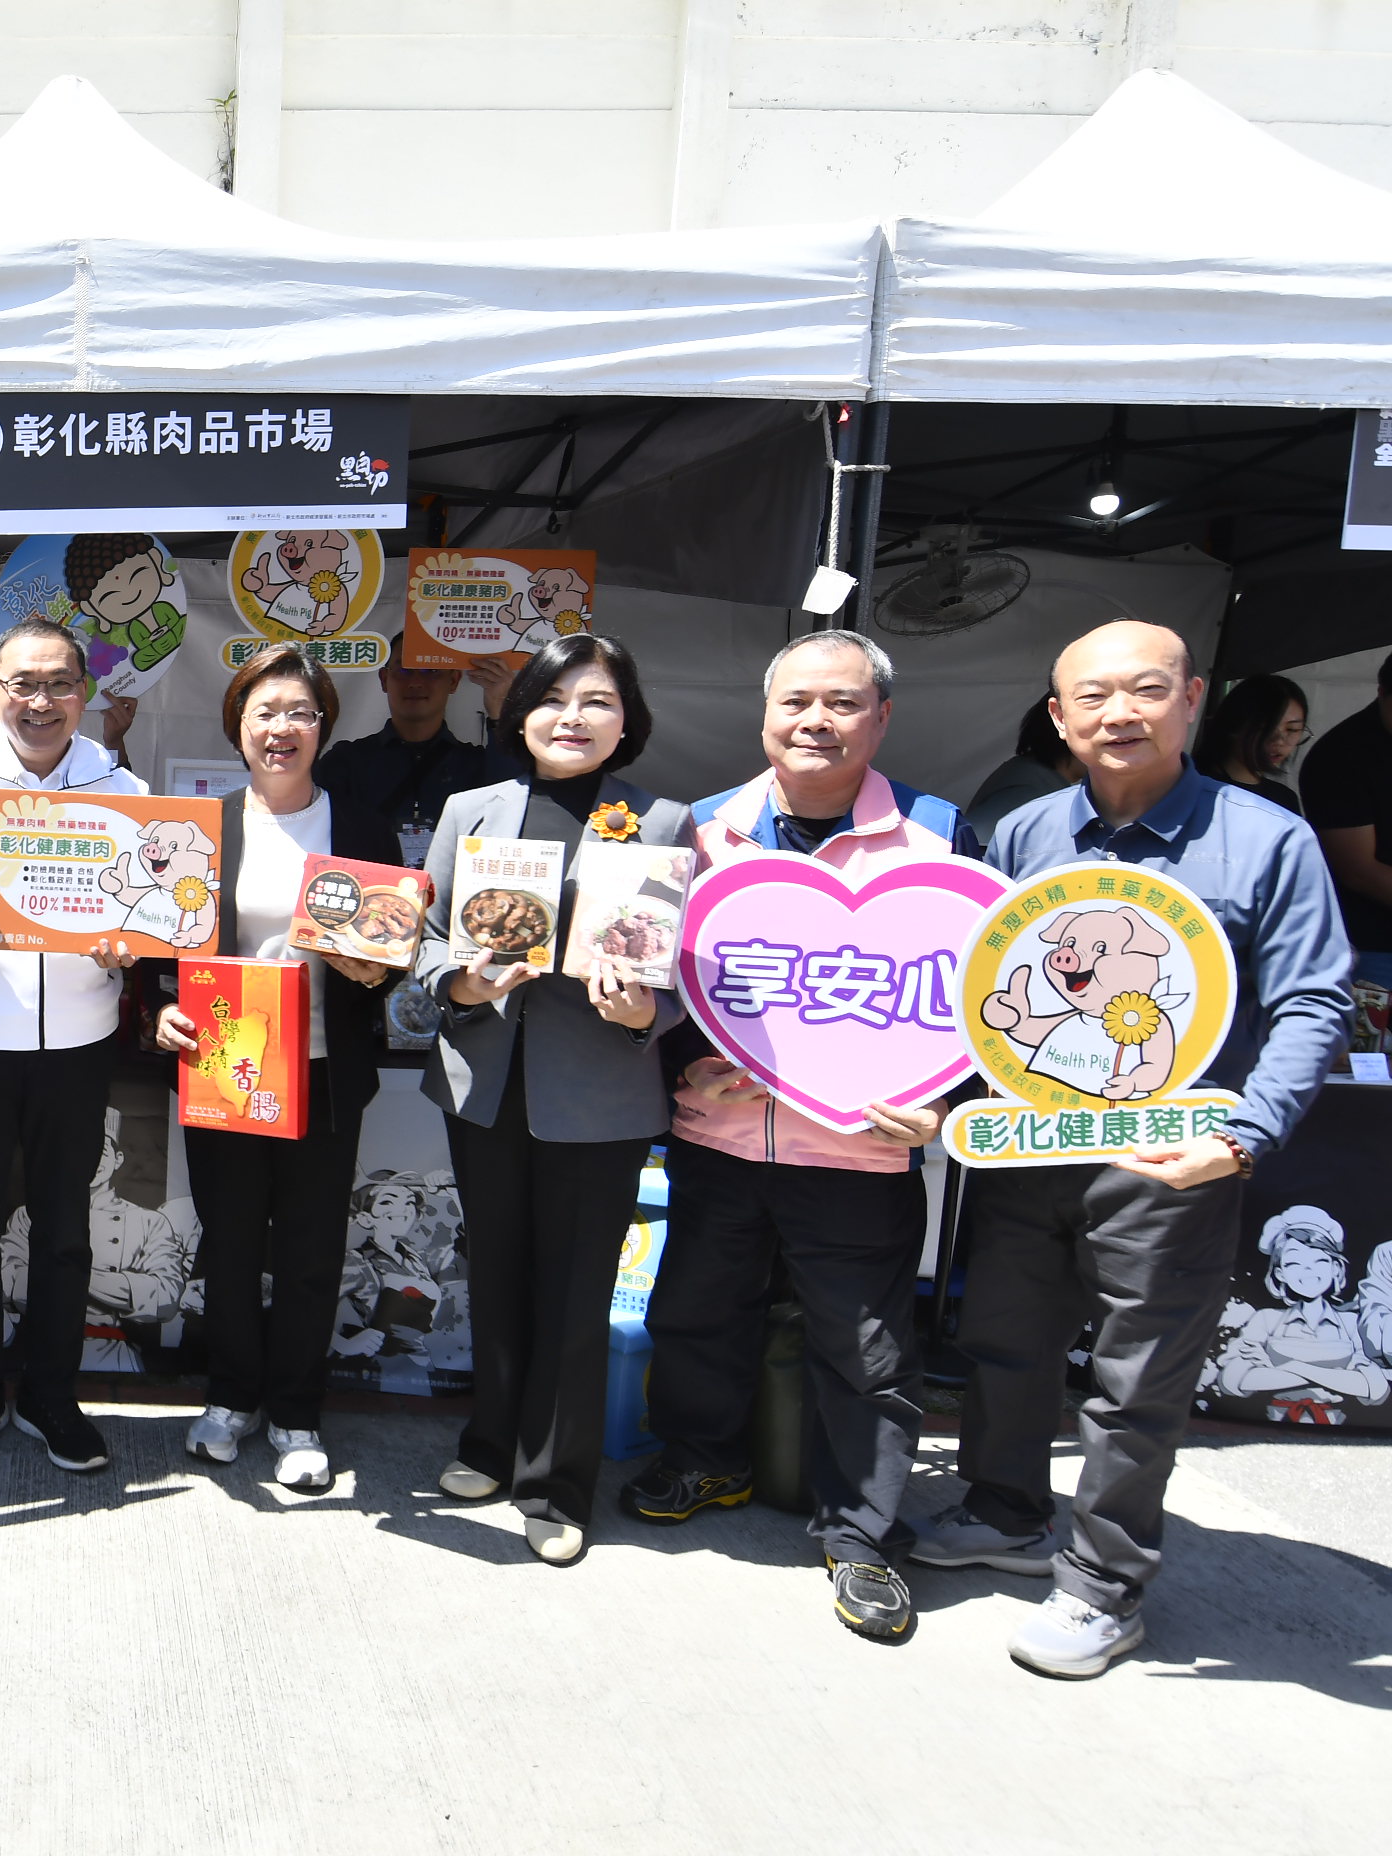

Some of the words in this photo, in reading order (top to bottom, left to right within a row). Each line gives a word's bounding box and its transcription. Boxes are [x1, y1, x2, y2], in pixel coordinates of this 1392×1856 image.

[13, 409, 333, 457] 彰化縣肉品市場
[422, 583, 507, 598] 彰化健康豬肉
[275, 602, 299, 617] Health
[300, 607, 312, 620] Pig
[437, 626, 466, 639] 100%
[232, 640, 377, 665] 彰康豬肉
[113, 677, 137, 695] County
[0, 836, 110, 858] 彰化健康豬肉
[21, 894, 59, 911] 100%
[136, 906, 162, 925] Health
[164, 916, 177, 928] Pig
[28, 935, 47, 945] No.
[717, 942, 956, 1030] 享安心
[1046, 1045, 1085, 1068] Health
[1090, 1054, 1110, 1072] Pig
[230, 1057, 281, 1124] 香腸
[970, 1104, 1230, 1153] 彰化健康豬肉
